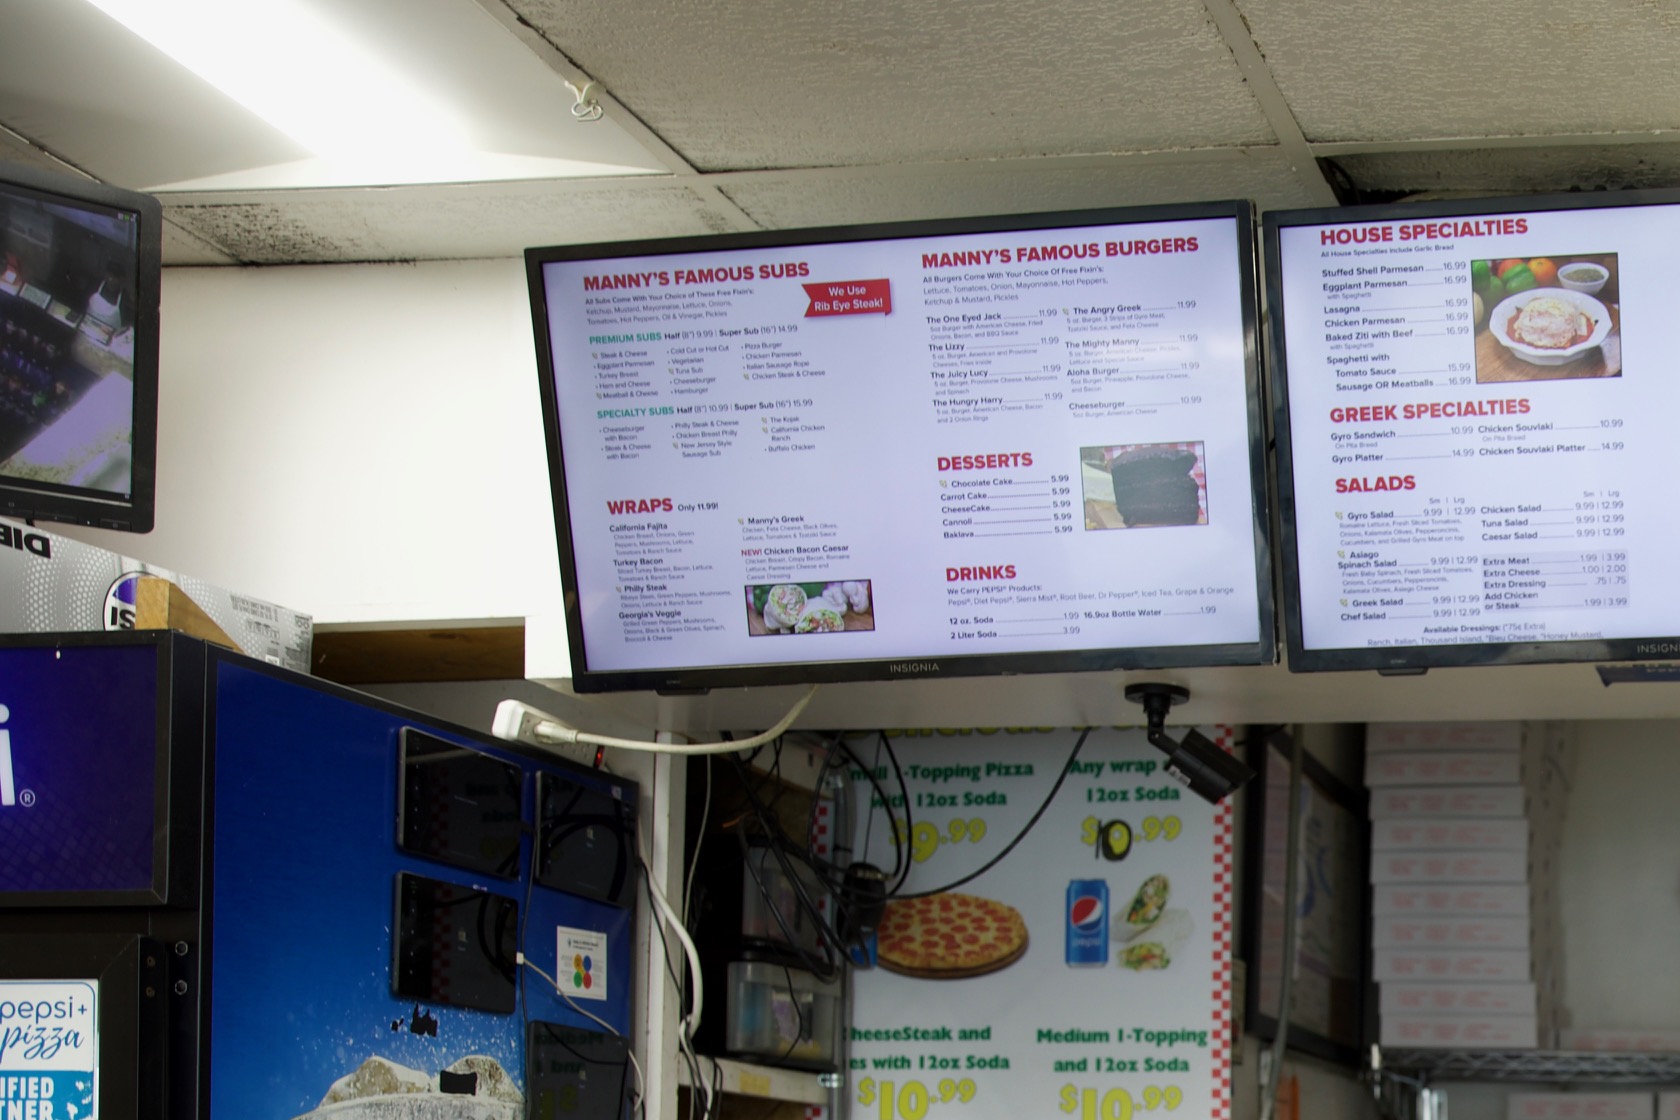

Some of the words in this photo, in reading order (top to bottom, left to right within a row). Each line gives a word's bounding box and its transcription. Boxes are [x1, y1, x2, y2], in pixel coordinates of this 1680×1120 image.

[1320, 226, 1394, 246] HOUSE
[1399, 218, 1529, 241] SPECIALTIES
[922, 249, 1012, 269] MANNY'S
[1016, 243, 1101, 263] FAMOUS
[1105, 236, 1199, 258] BURGERS
[584, 271, 670, 291] MANNY'S
[674, 266, 755, 286] FAMOUS
[759, 262, 810, 279] SUBS
[828, 285, 847, 297] We
[847, 284, 867, 296] Use
[814, 301, 831, 313] Rib
[832, 300, 851, 313] Eye
[853, 298, 884, 311] Steak!
[589, 334, 635, 345] PREMIUM
[636, 332, 662, 343] SUBS
[597, 408, 647, 420] SPECIALTY
[648, 405, 675, 417] SUBS
[1329, 404, 1398, 424] GREEK
[1403, 398, 1532, 420] SPECIALTIES
[937, 452, 1034, 472] DESSERTS
[951, 478, 991, 489] Chocolate
[993, 477, 1013, 487] Cake
[1050, 474, 1070, 484] 5.99
[1335, 475, 1417, 494] SALADS
[607, 498, 674, 516] WRAPS
[677, 503, 696, 514] Only
[697, 502, 719, 512] 11.99!
[946, 564, 1017, 582] DRINKS
[890, 663, 940, 673] INSIGNIA
[898, 764, 982, 782] -Topping
[986, 763, 1034, 777] Pizza
[1070, 760, 1104, 778] Any
[1110, 760, 1156, 775] wrap
[917, 792, 958, 808] 12oz
[963, 791, 1008, 806] Soda
[1087, 788, 1129, 802] 12oz
[1135, 786, 1180, 801] Soda
[0, 996, 73, 1025] pepsi
[849, 1025, 952, 1041] heeseSteak
[959, 1026, 991, 1041] and
[1037, 1028, 1109, 1043] Medium
[1118, 1027, 1207, 1047] 1-Topping
[0, 1024, 85, 1064] pizza
[872, 1055, 911, 1069] with
[919, 1055, 960, 1069] 12oz
[966, 1055, 1010, 1069] Soda
[1054, 1058, 1087, 1072] and
[1096, 1058, 1137, 1072] 12oz
[1144, 1057, 1189, 1072] Soda
